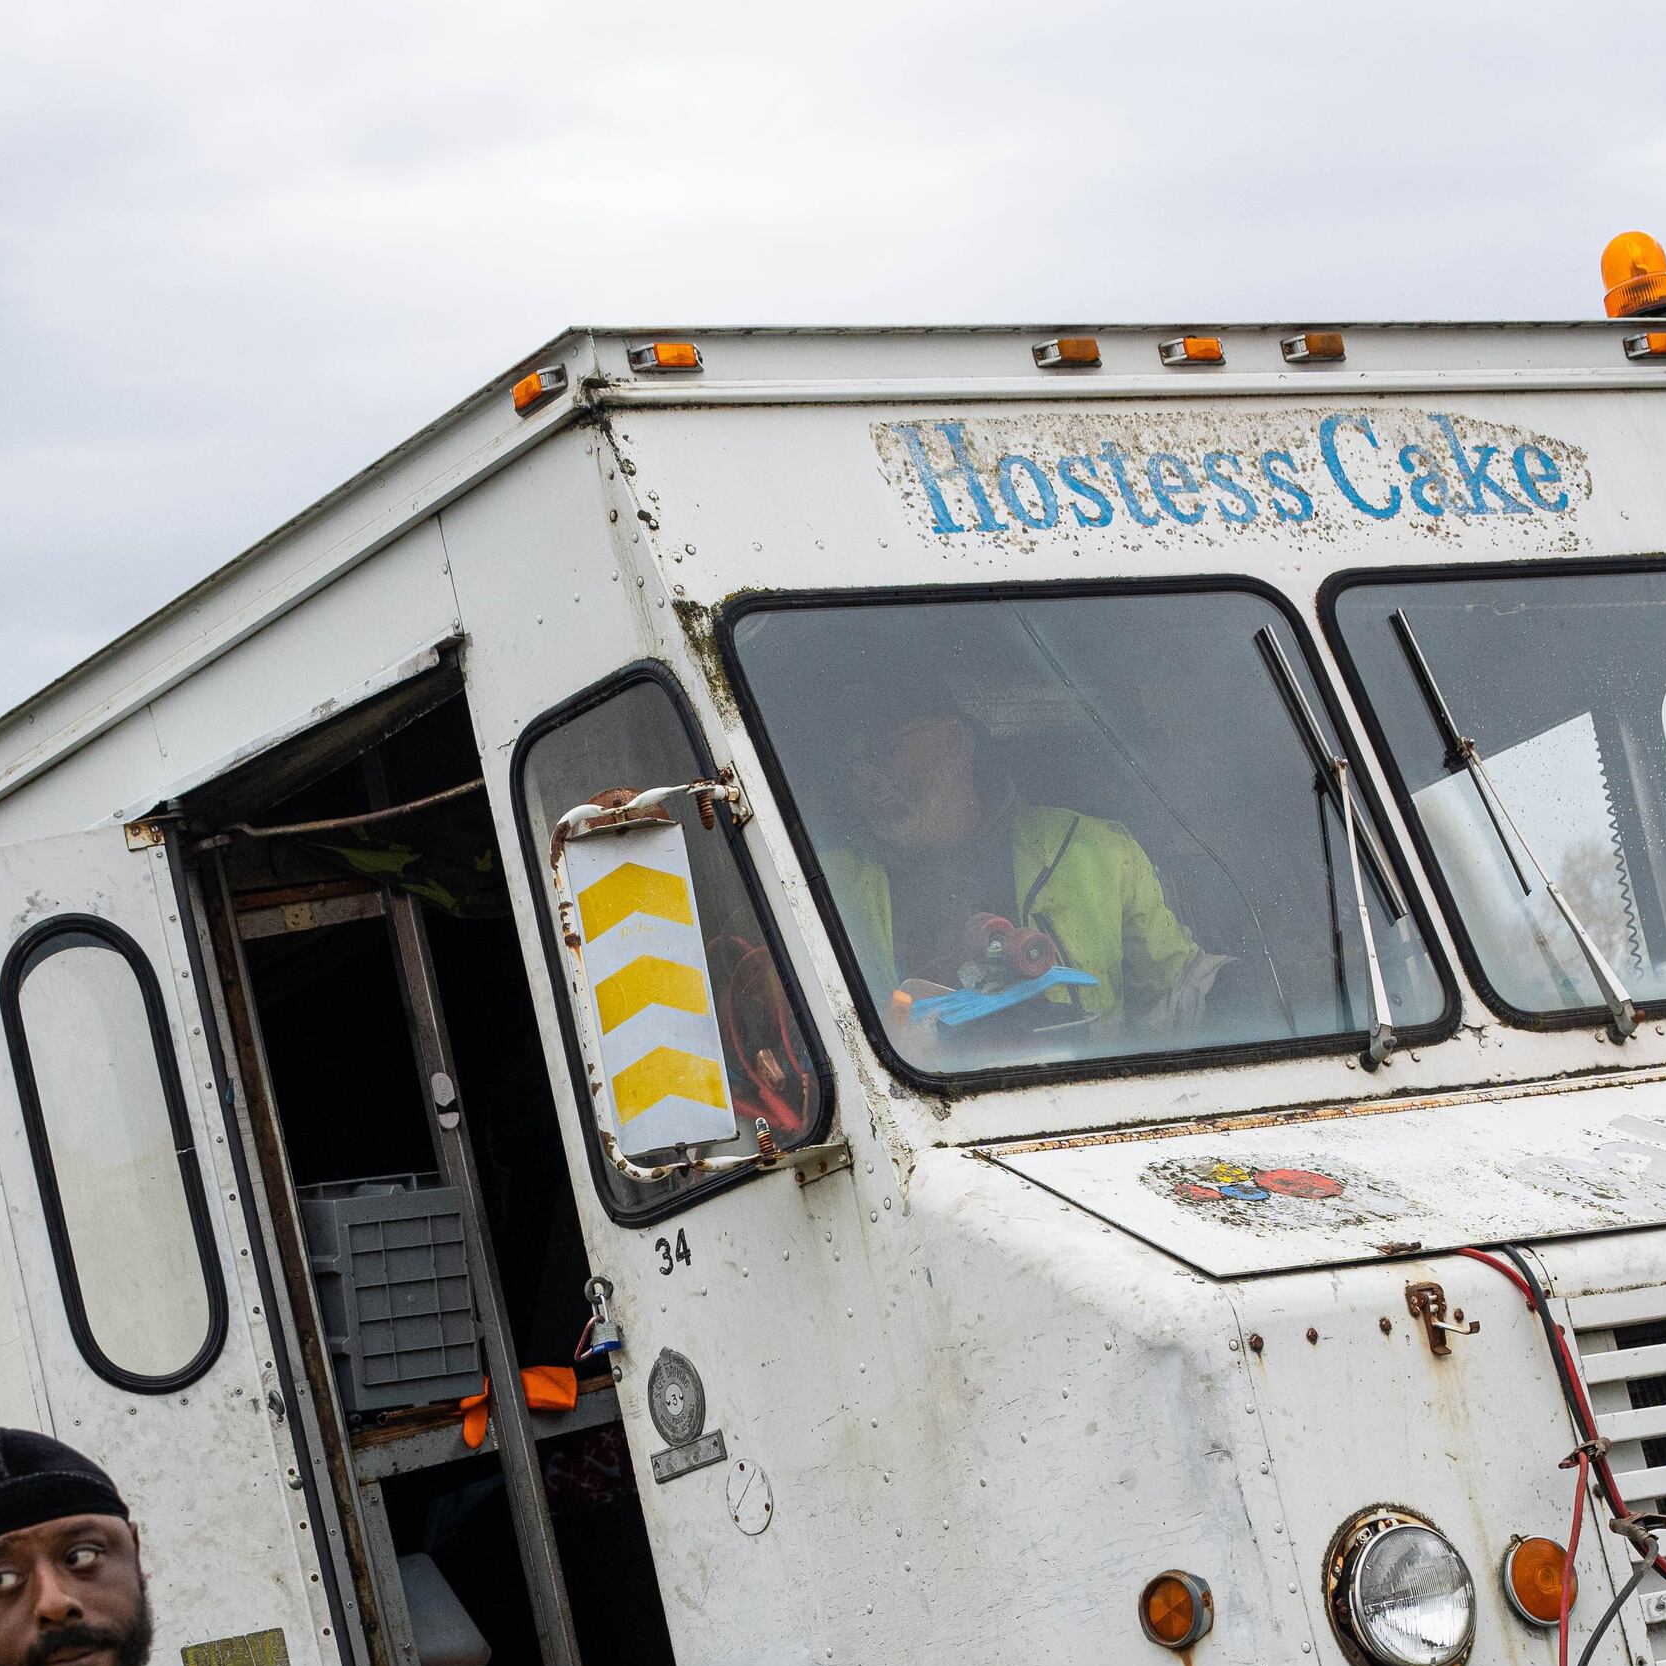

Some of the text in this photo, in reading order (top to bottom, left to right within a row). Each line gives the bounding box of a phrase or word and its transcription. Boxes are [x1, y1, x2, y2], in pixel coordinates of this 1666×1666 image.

[888, 410, 1570, 536] Hostess Cake
[654, 1227, 692, 1276] 34
[671, 1393, 678, 1406] 3
